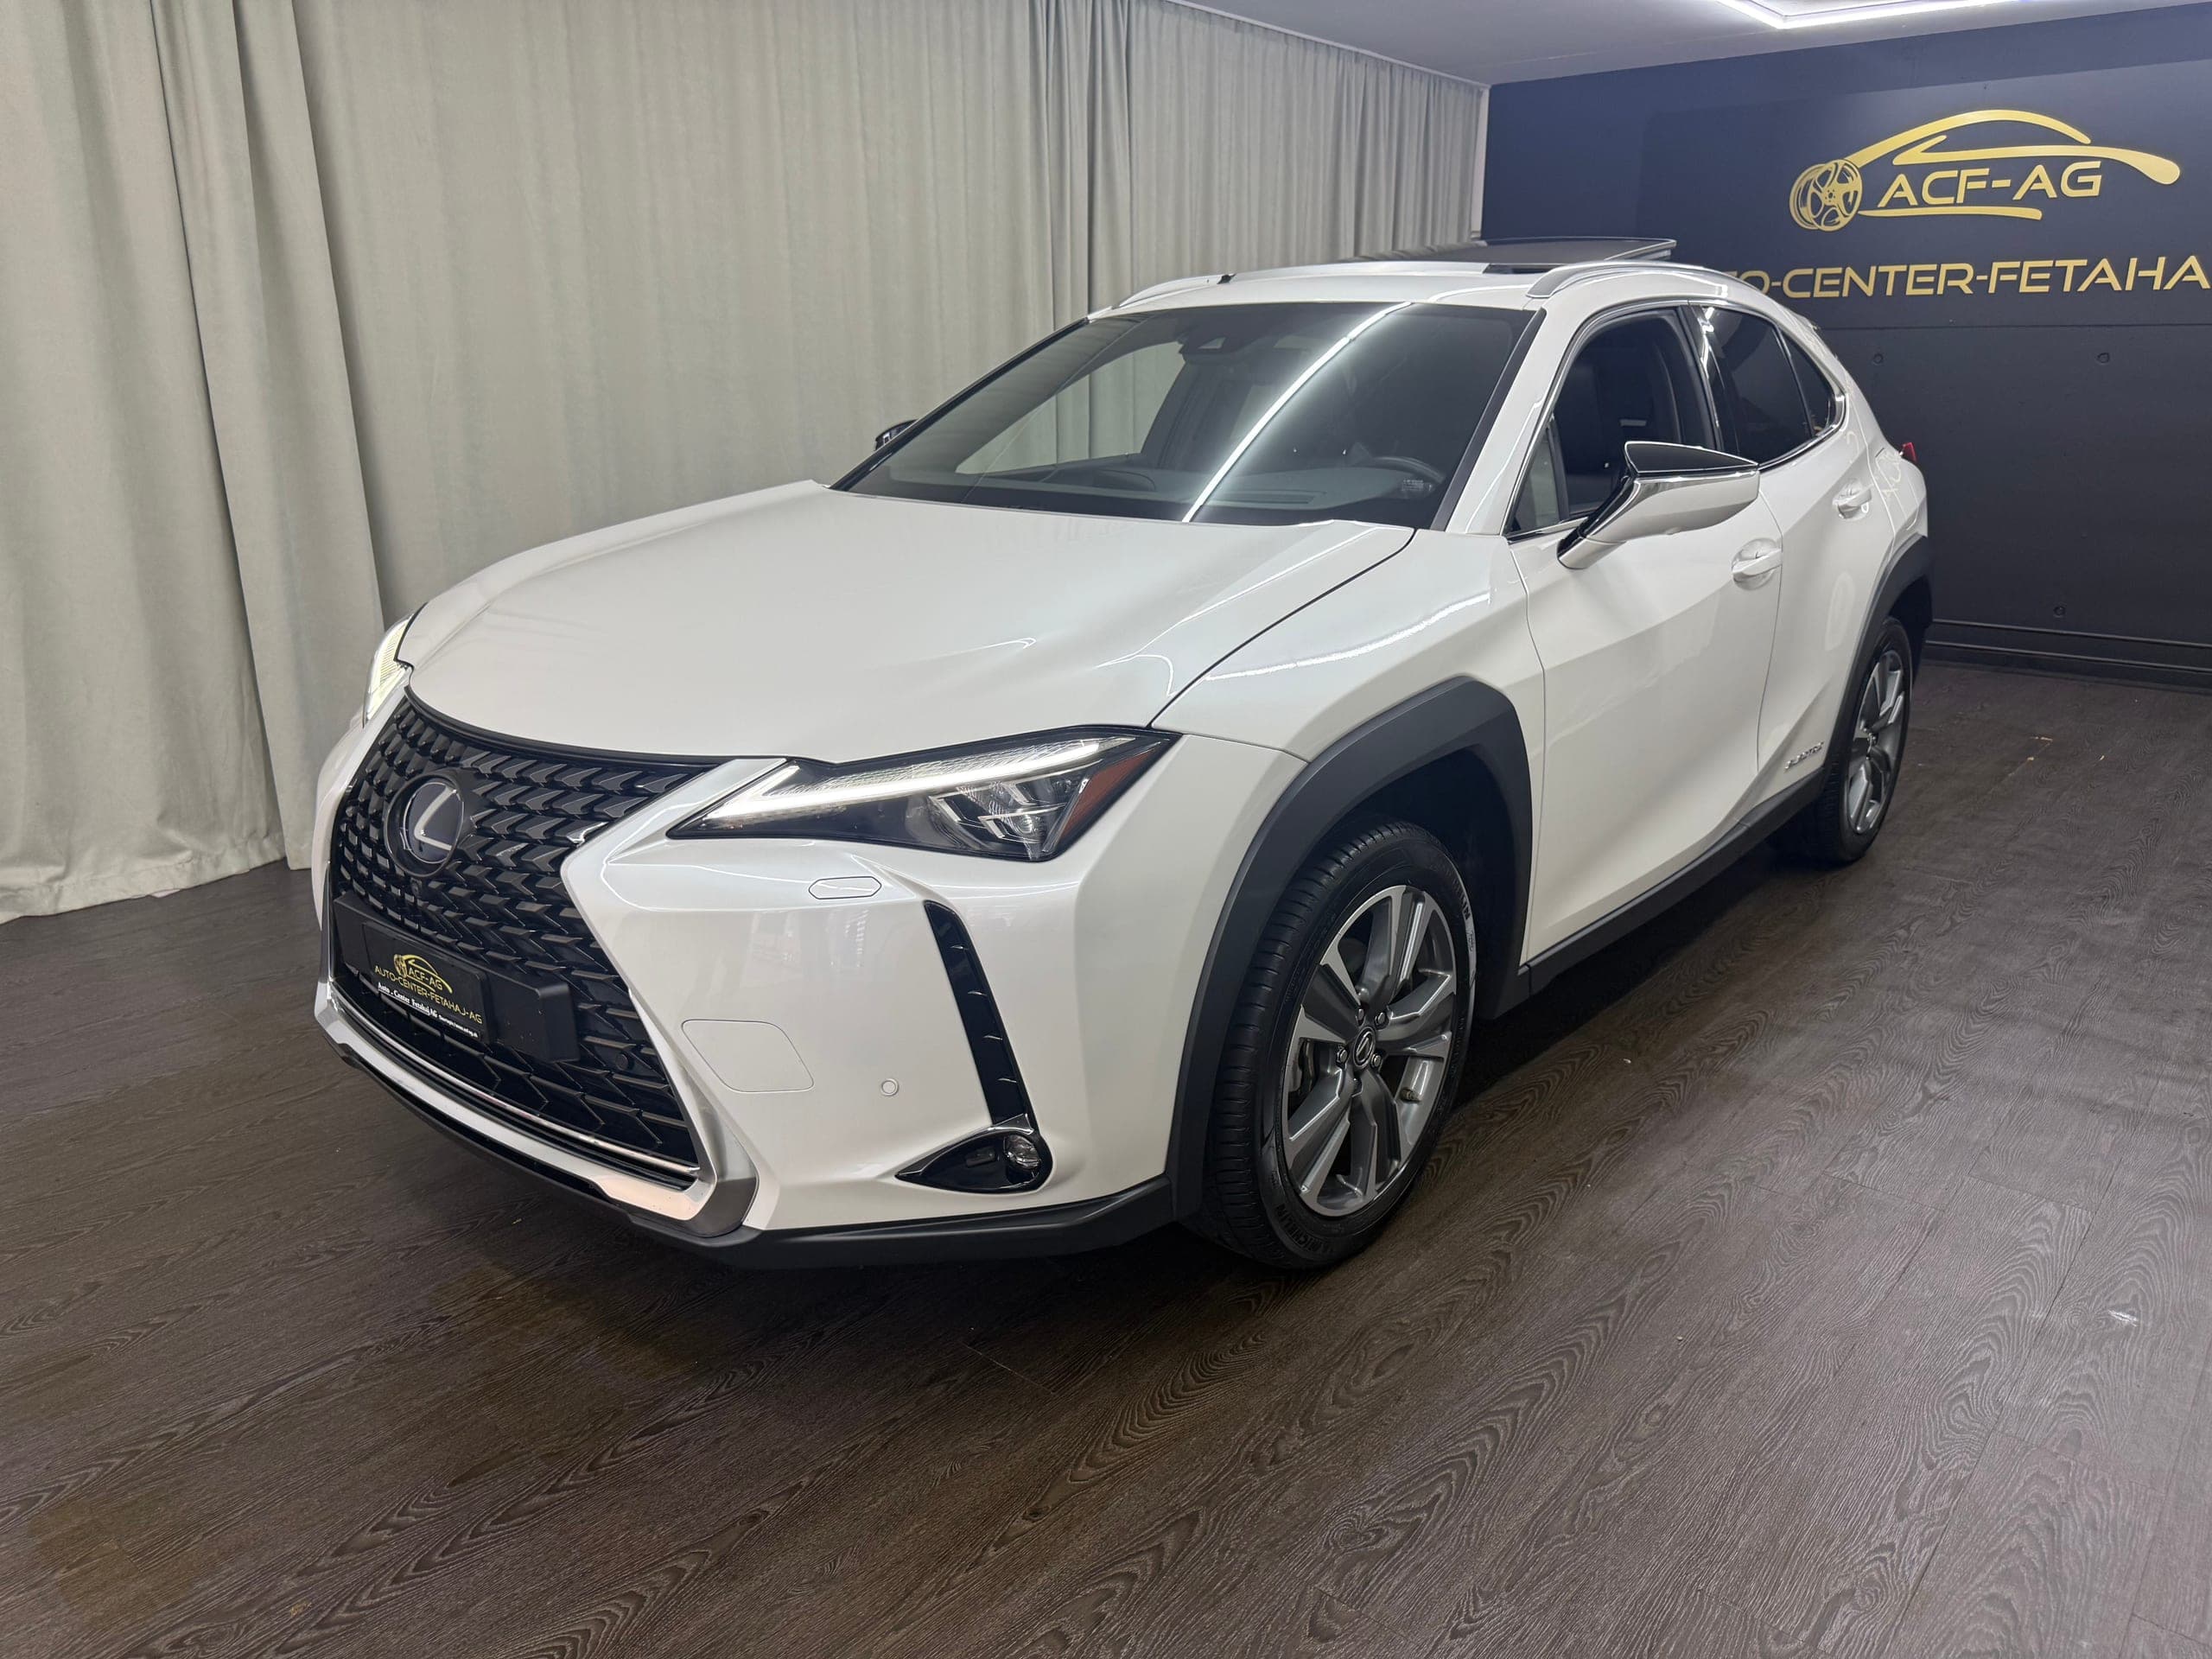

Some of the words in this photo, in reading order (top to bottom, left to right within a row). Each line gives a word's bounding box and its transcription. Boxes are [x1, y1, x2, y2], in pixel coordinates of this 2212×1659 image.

[1878, 160, 2102, 207] ACF-AG
[1726, 254, 2211, 298] O-CENTER-FETAHA
[374, 965, 483, 1025] AUTO-CENTER-FETAHAJ-AG
[408, 967, 443, 991] ACF-AG
